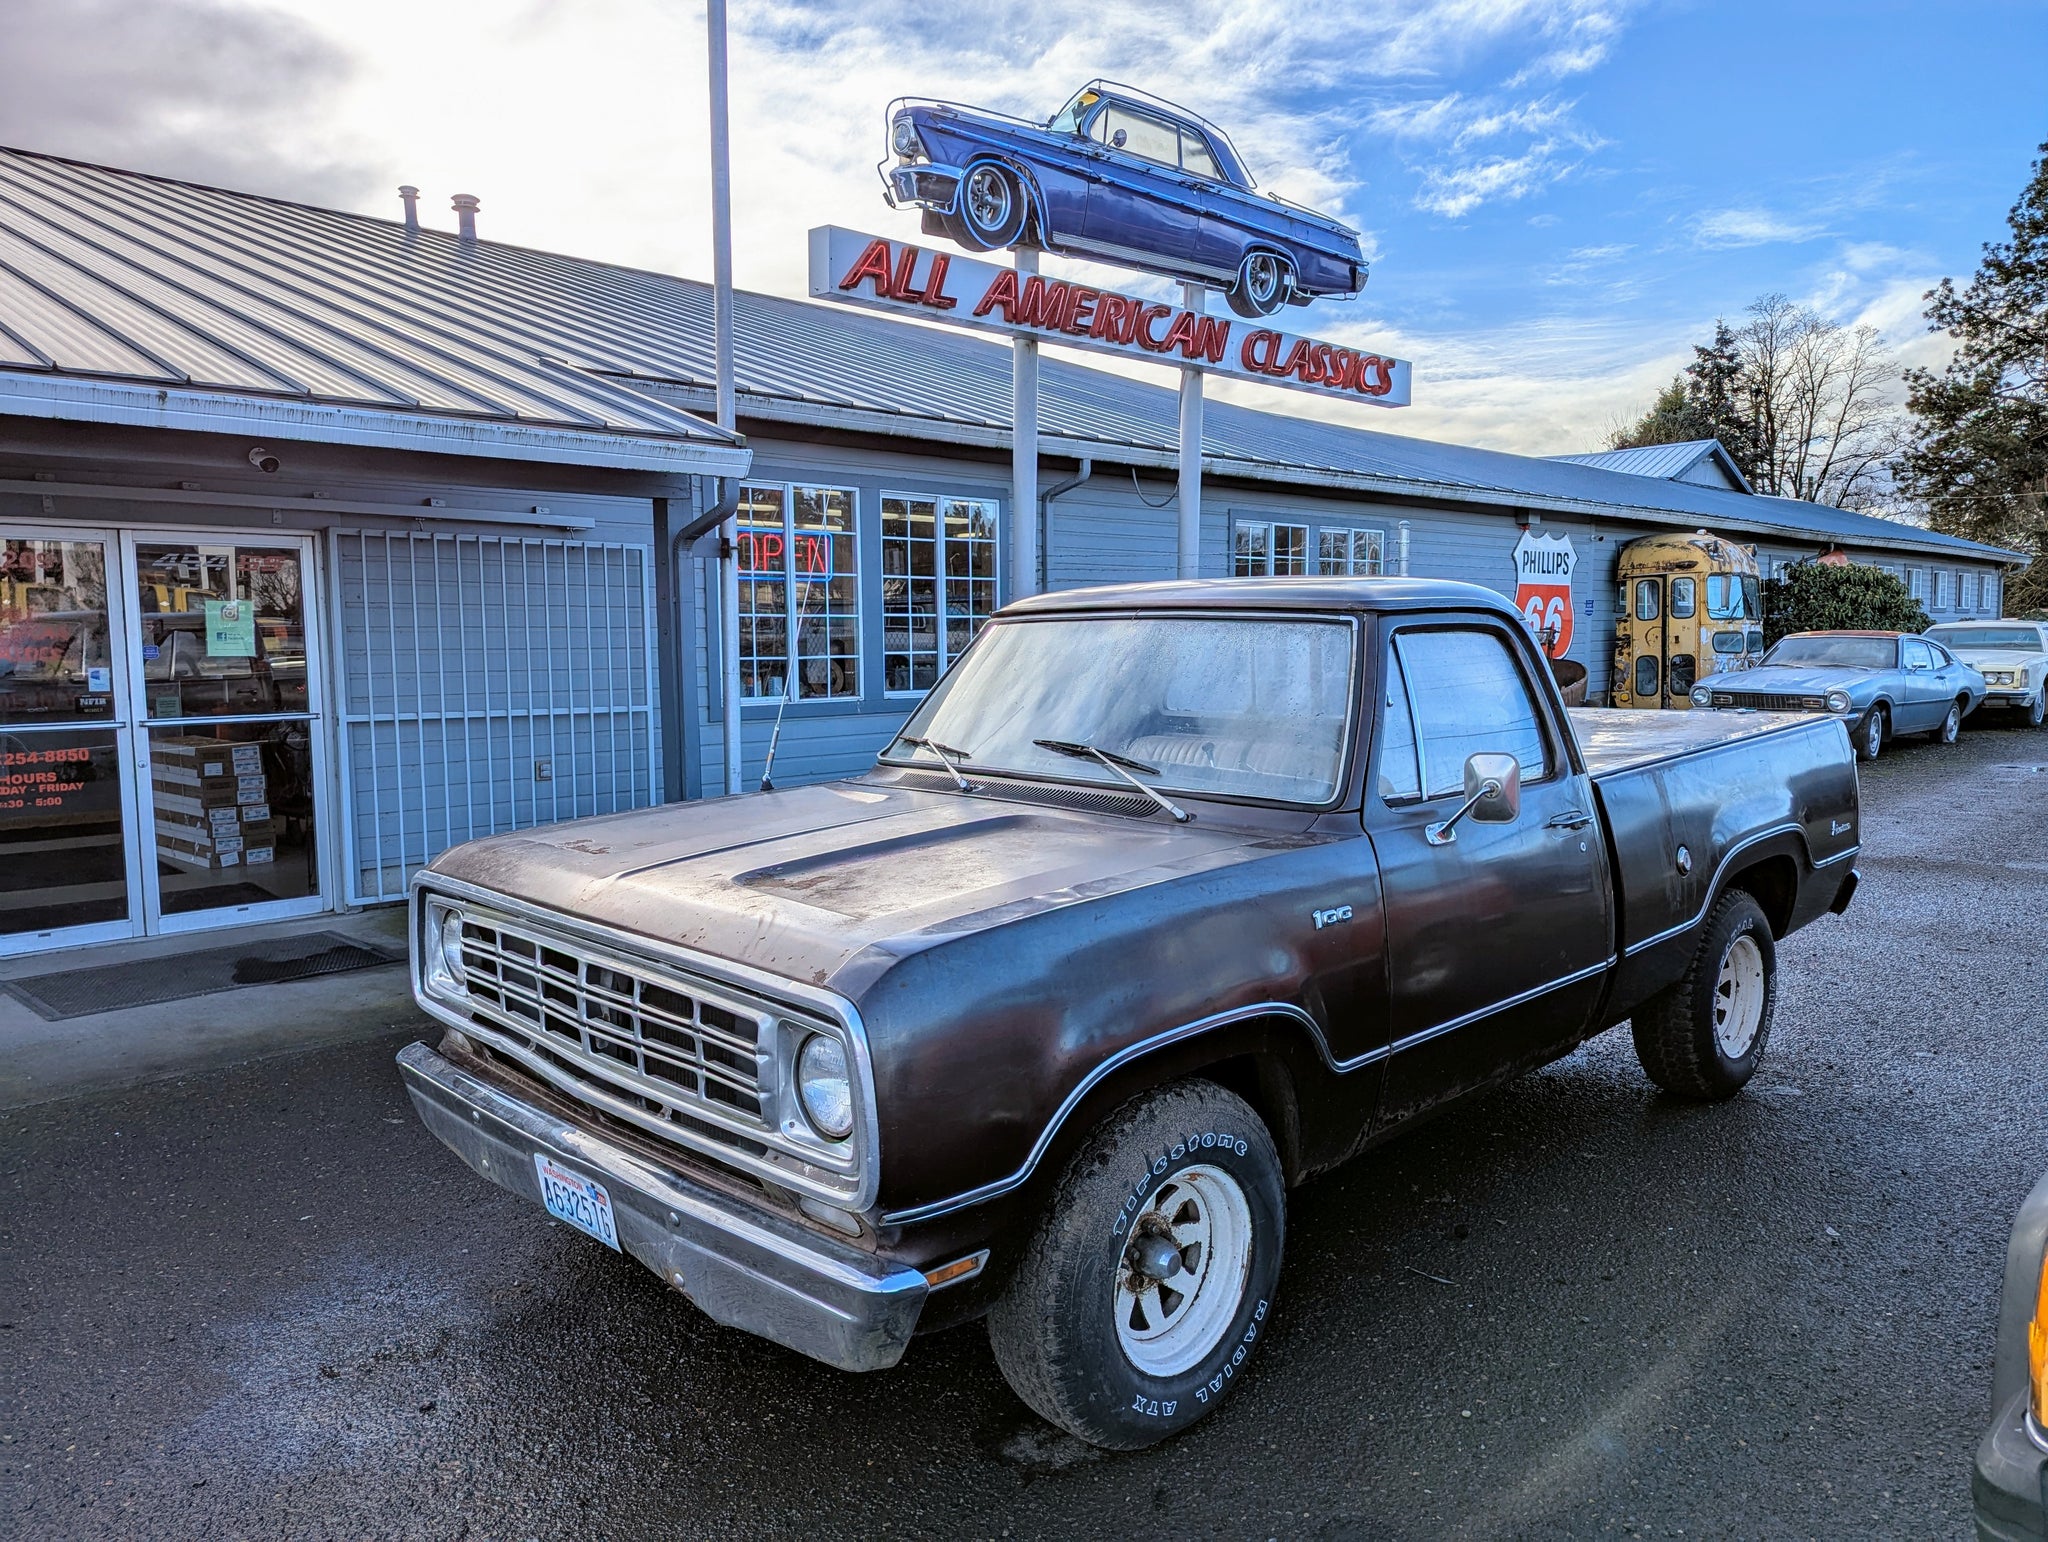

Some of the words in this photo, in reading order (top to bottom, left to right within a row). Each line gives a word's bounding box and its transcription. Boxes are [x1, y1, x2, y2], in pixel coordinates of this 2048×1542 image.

[838, 238, 958, 310] ALL
[972, 268, 1232, 364] AMERICAN
[1240, 328, 1397, 397] CLASSICS
[1522, 550, 1570, 576] PHILLIPS
[1524, 595, 1564, 646] 66
[38, 782, 85, 793] FRIDAY
[35, 796, 63, 807] 5:00
[542, 1165, 584, 1192] WASHINGTON
[1195, 1299, 1269, 1404] RADIAL
[1131, 1394, 1178, 1417] ATX
